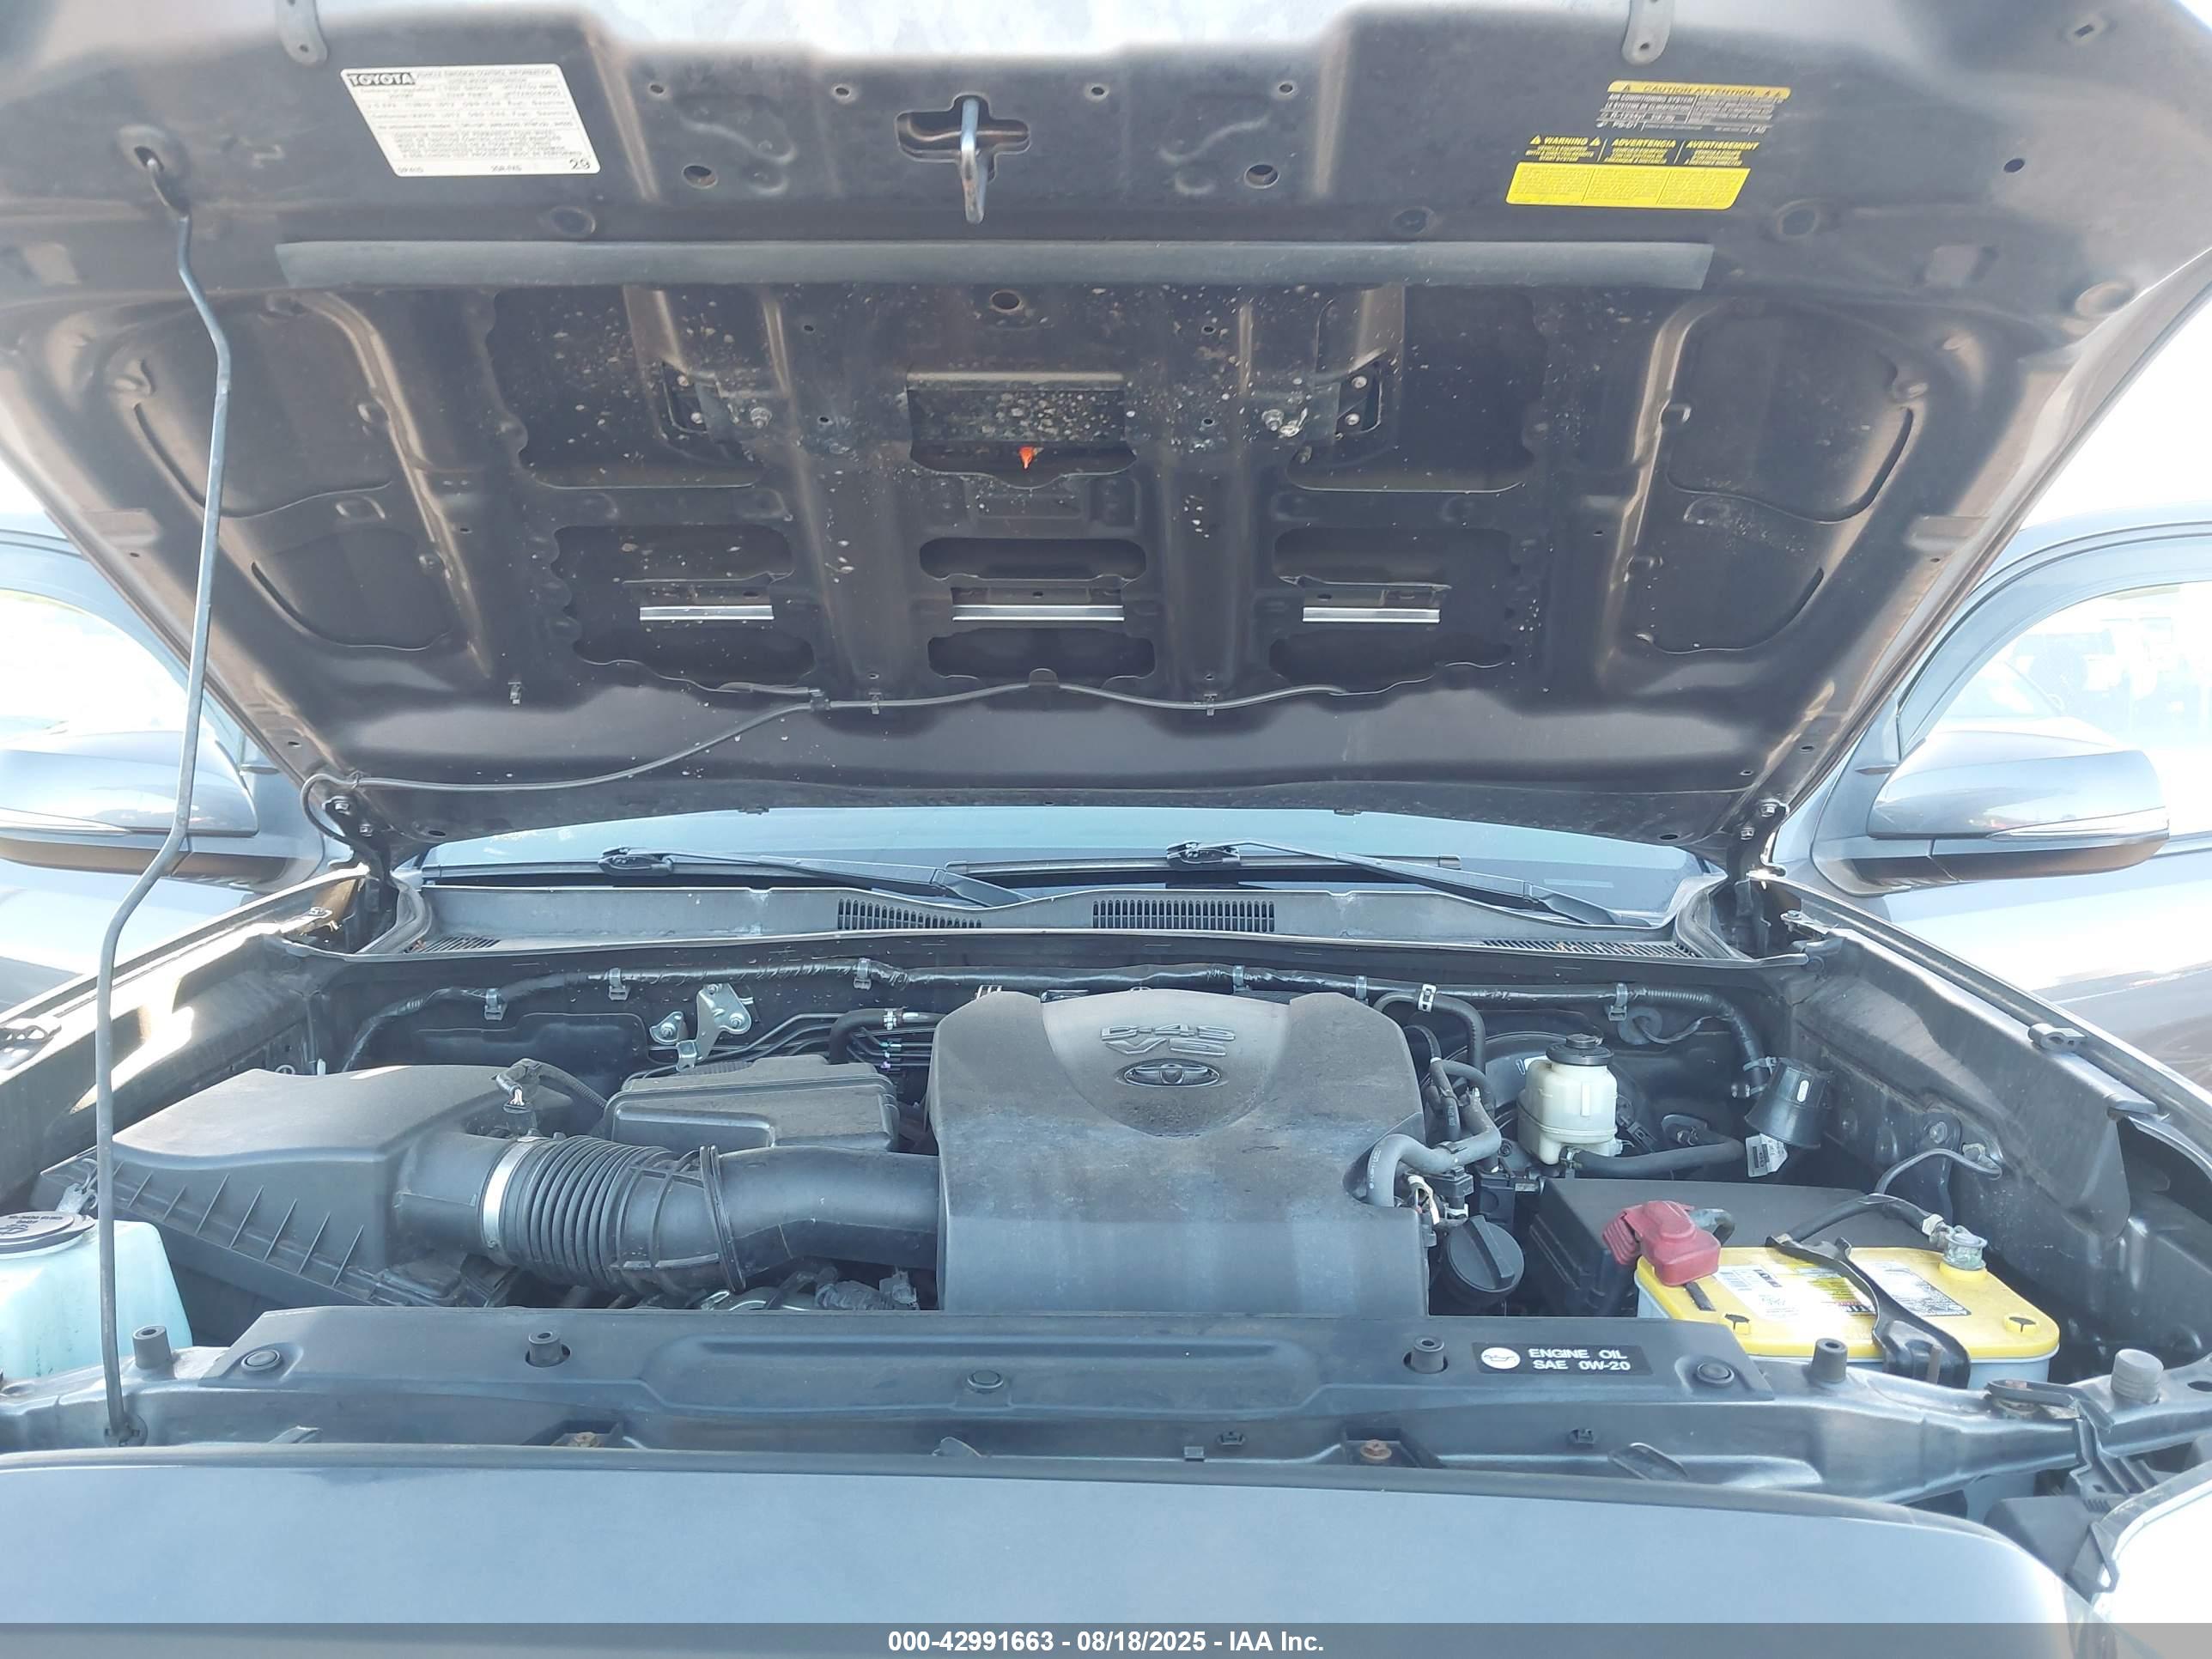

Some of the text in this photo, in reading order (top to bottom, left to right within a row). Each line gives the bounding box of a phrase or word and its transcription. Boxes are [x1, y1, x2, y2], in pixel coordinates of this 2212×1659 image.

[347, 73, 415, 86] TOYOTA
[1544, 136, 1589, 145] WARNING
[1611, 138, 1676, 149] ADVERTENCIA
[1686, 141, 1760, 150] AVERTISSEMENT
[1105, 1037, 1227, 1056] V6
[1528, 1348, 1628, 1359] ENGINE OIL
[1533, 1359, 1631, 1370] SAE 0W-20
